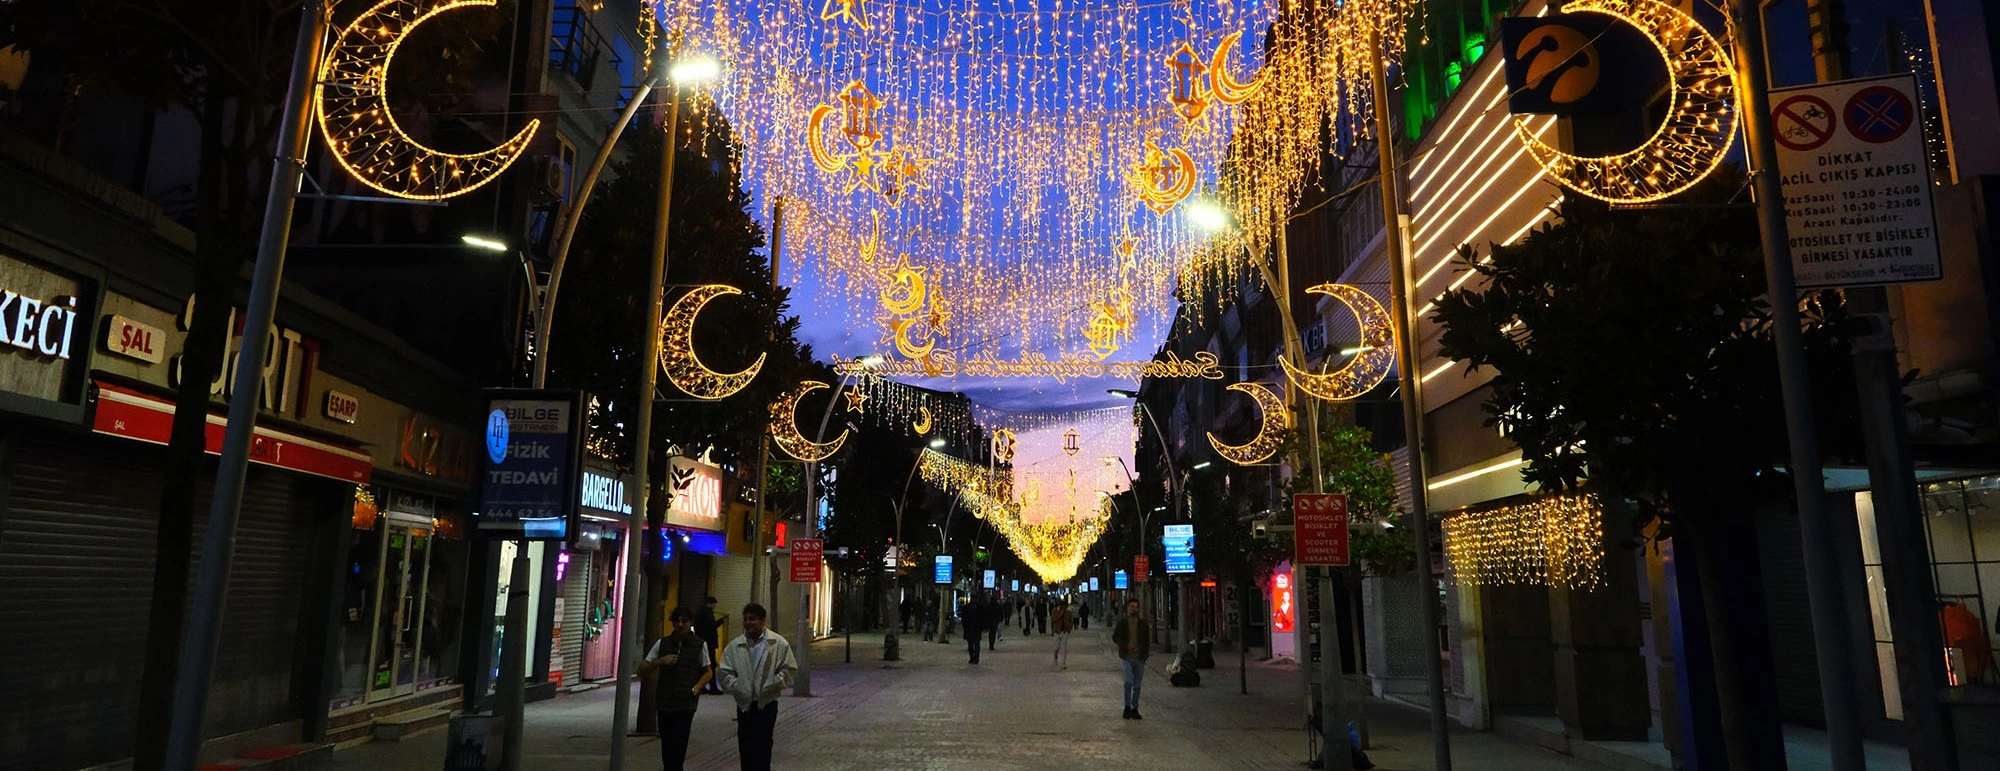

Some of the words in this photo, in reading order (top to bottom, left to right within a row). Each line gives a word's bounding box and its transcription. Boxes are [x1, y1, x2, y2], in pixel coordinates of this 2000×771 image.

[1819, 151, 1872, 166] DİKKAT
[1782, 171, 1814, 186] ACİL
[1865, 163, 1916, 178] KAPISI
[1789, 233, 1852, 249] OTOSİKLET
[1857, 232, 1872, 243] VE
[1853, 246, 1913, 261] YASAKTIR
[120, 324, 153, 355] ŞAL
[490, 466, 559, 486] TEDAVİ
[582, 471, 624, 513] BARGELLO
